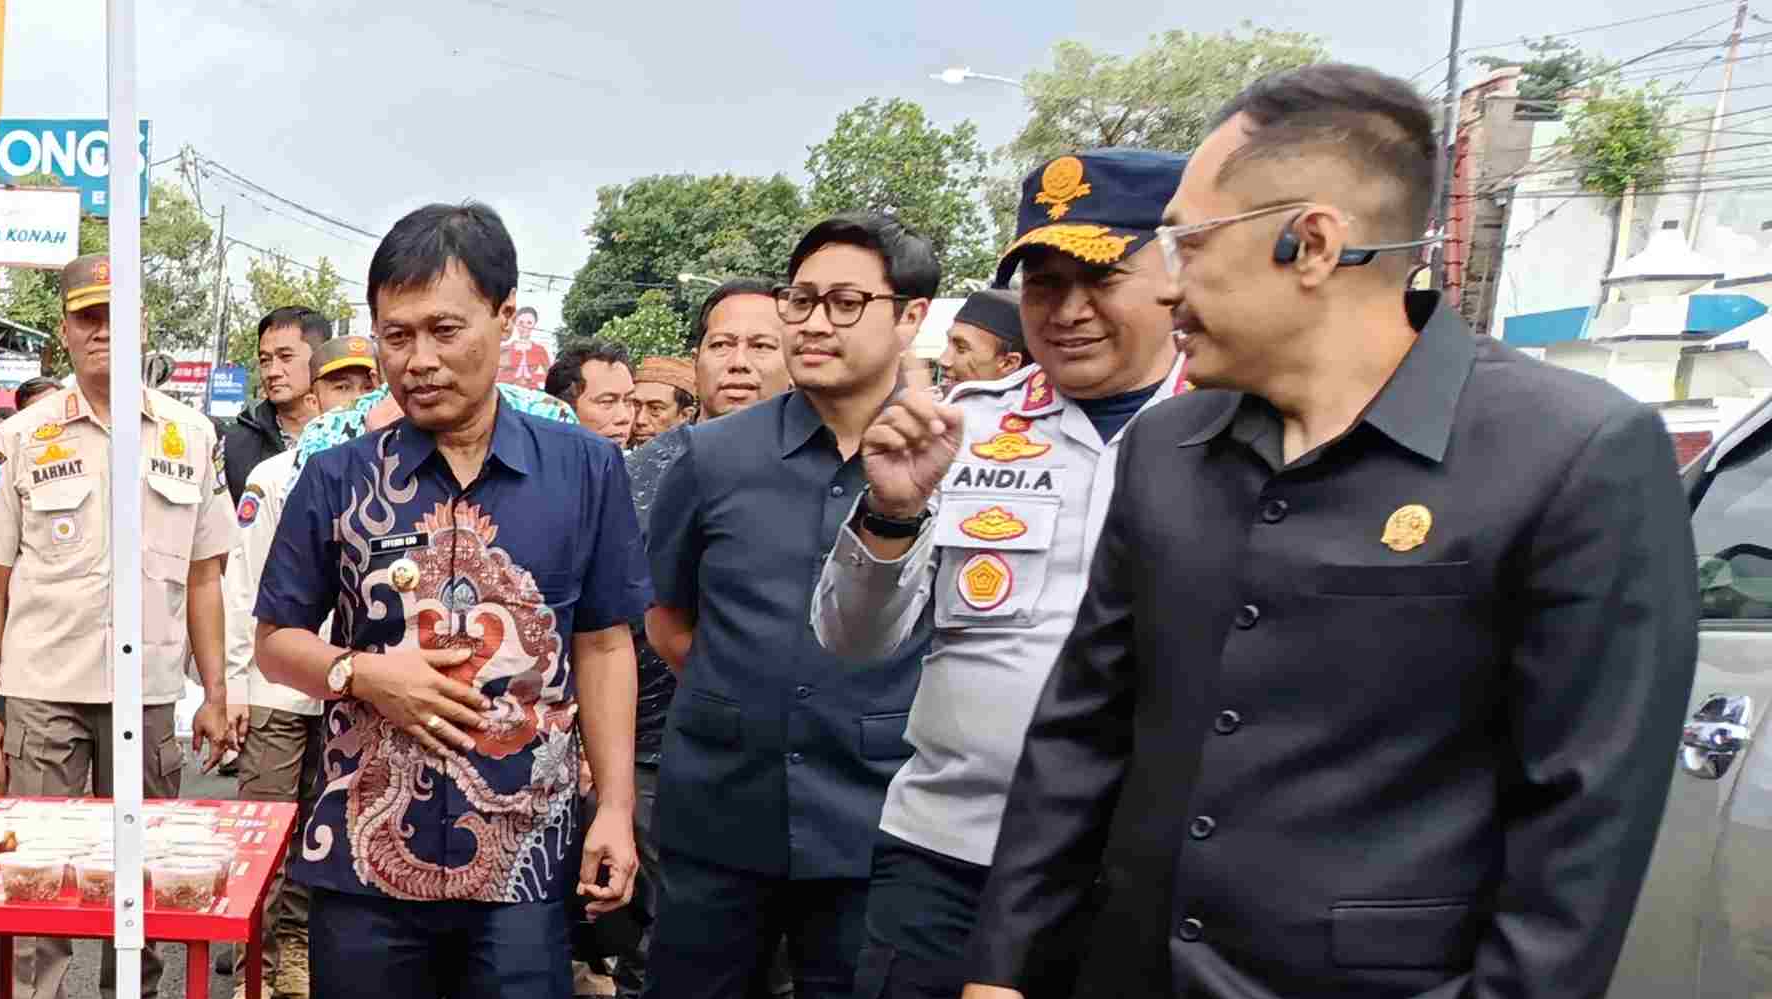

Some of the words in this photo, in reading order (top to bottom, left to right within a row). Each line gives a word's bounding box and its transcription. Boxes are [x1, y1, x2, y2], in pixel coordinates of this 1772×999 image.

[6, 227, 68, 244] KONAH
[32, 459, 84, 484] RAHMAT
[150, 458, 175, 475] POL
[178, 461, 195, 479] PP
[953, 466, 1053, 491] ANDI.A
